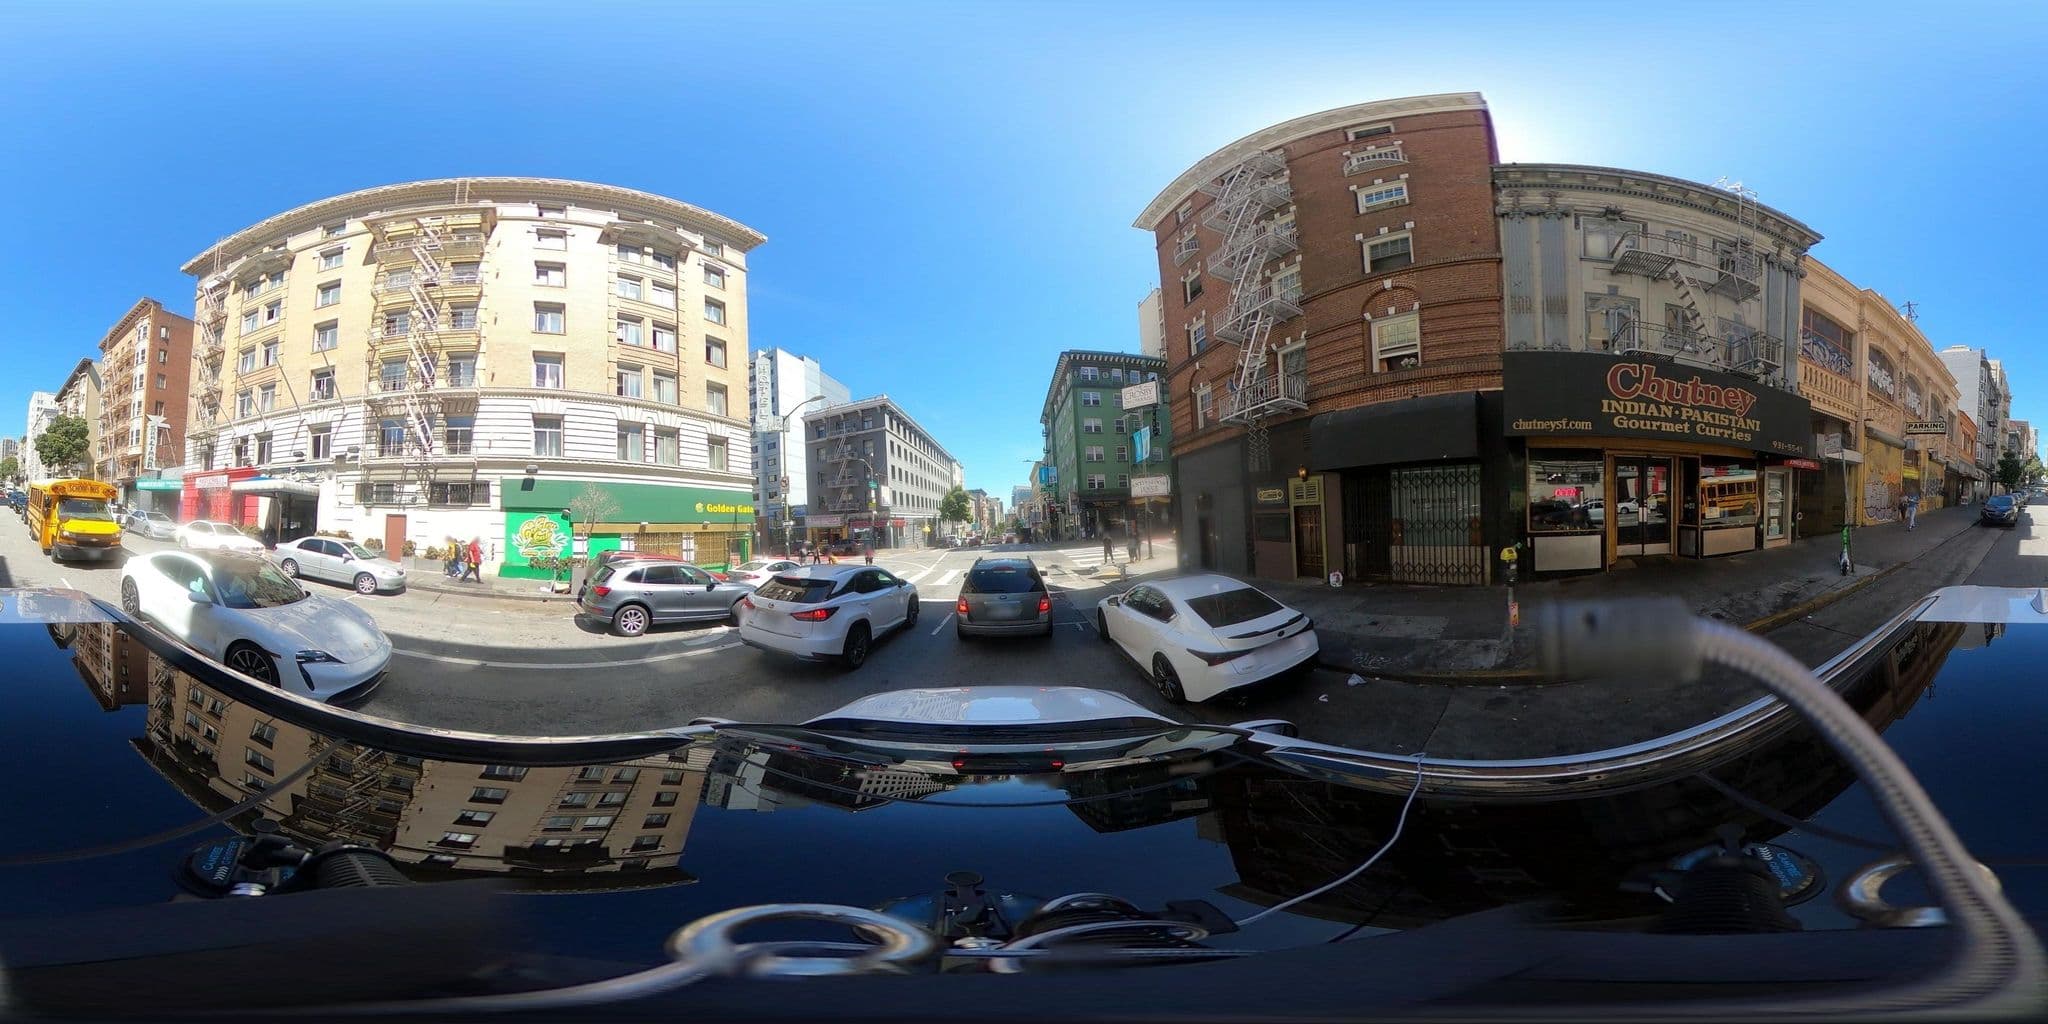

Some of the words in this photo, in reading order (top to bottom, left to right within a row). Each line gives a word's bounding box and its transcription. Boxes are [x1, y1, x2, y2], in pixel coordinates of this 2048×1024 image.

[1607, 363, 1757, 417] Chutney
[1512, 418, 1593, 432] chutneysf.com
[1613, 416, 1691, 434] Gourmet
[1696, 423, 1752, 442] Curries
[706, 503, 736, 513] Golden
[737, 504, 754, 514] Gate
